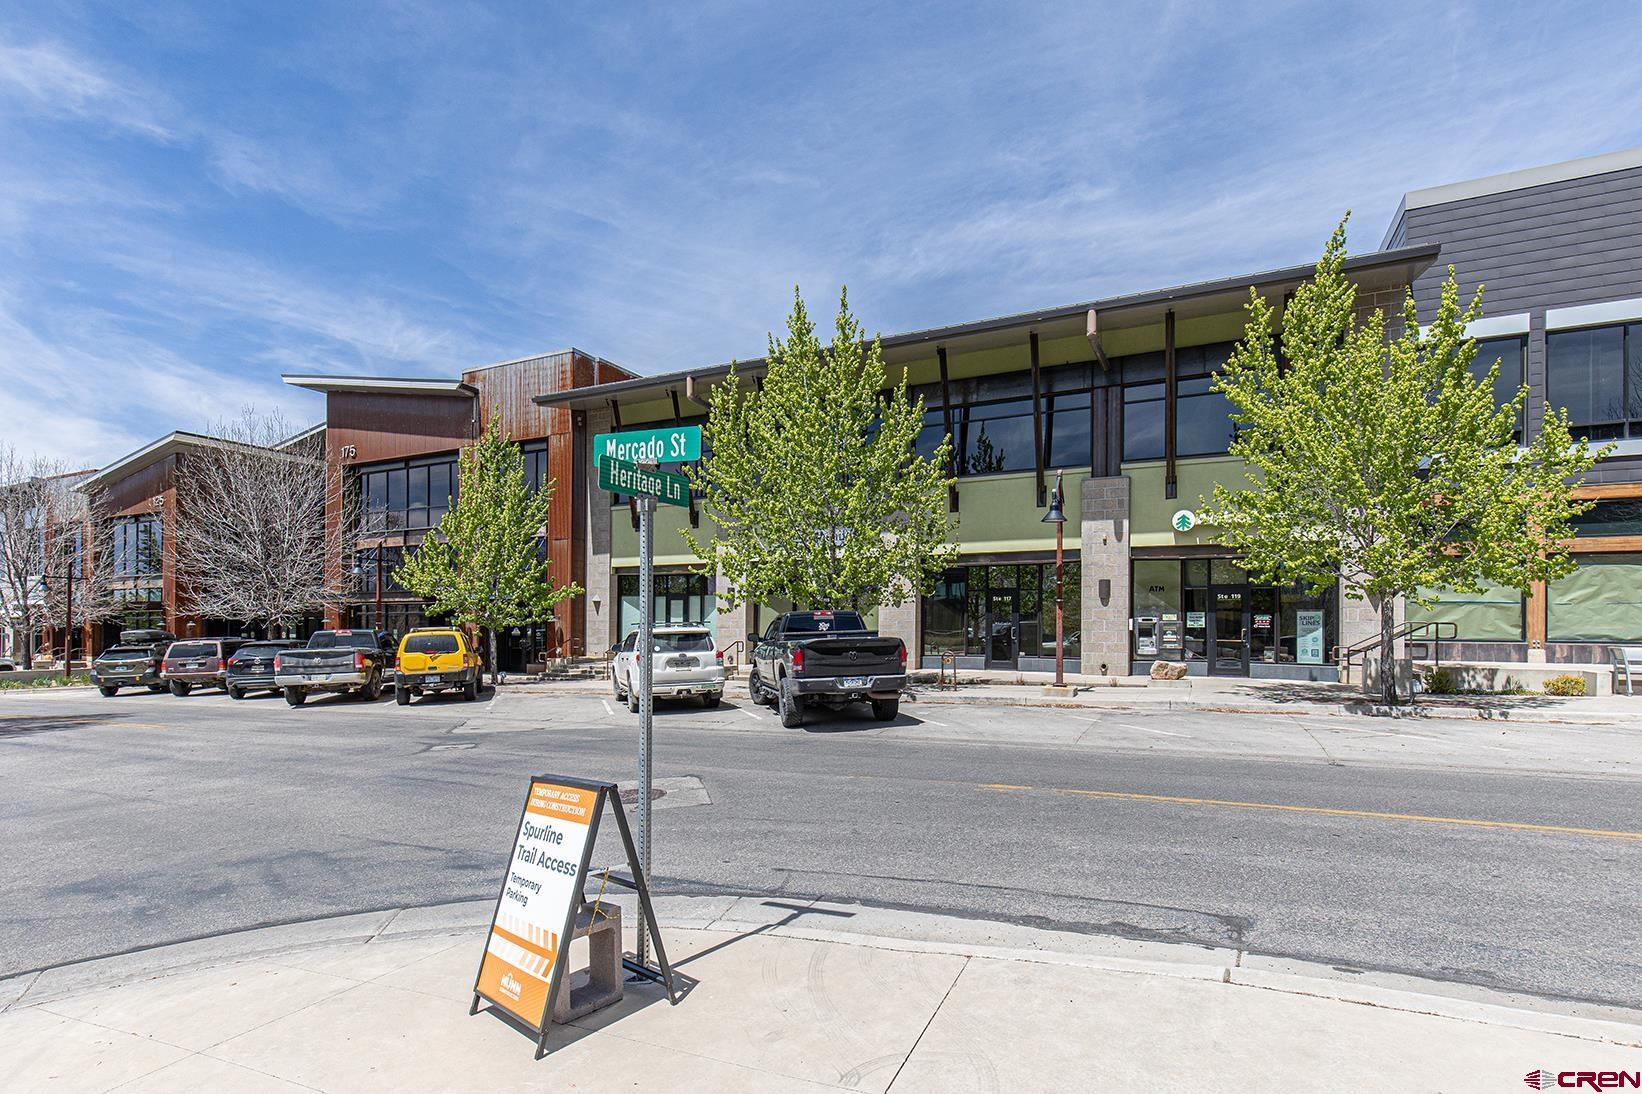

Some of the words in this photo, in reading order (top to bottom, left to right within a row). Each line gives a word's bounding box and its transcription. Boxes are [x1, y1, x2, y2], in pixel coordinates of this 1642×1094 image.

[341, 444, 356, 458] 175
[606, 435, 664, 460] Mercado
[670, 432, 686, 457] St
[610, 460, 662, 496] Heritage
[666, 475, 681, 500] Ln
[1148, 585, 1165, 593] ATM
[523, 821, 563, 845] Spurline
[517, 844, 538, 865] Trail
[536, 851, 578, 877] Access
[510, 871, 543, 895] Temporary
[505, 887, 529, 908] Parking
